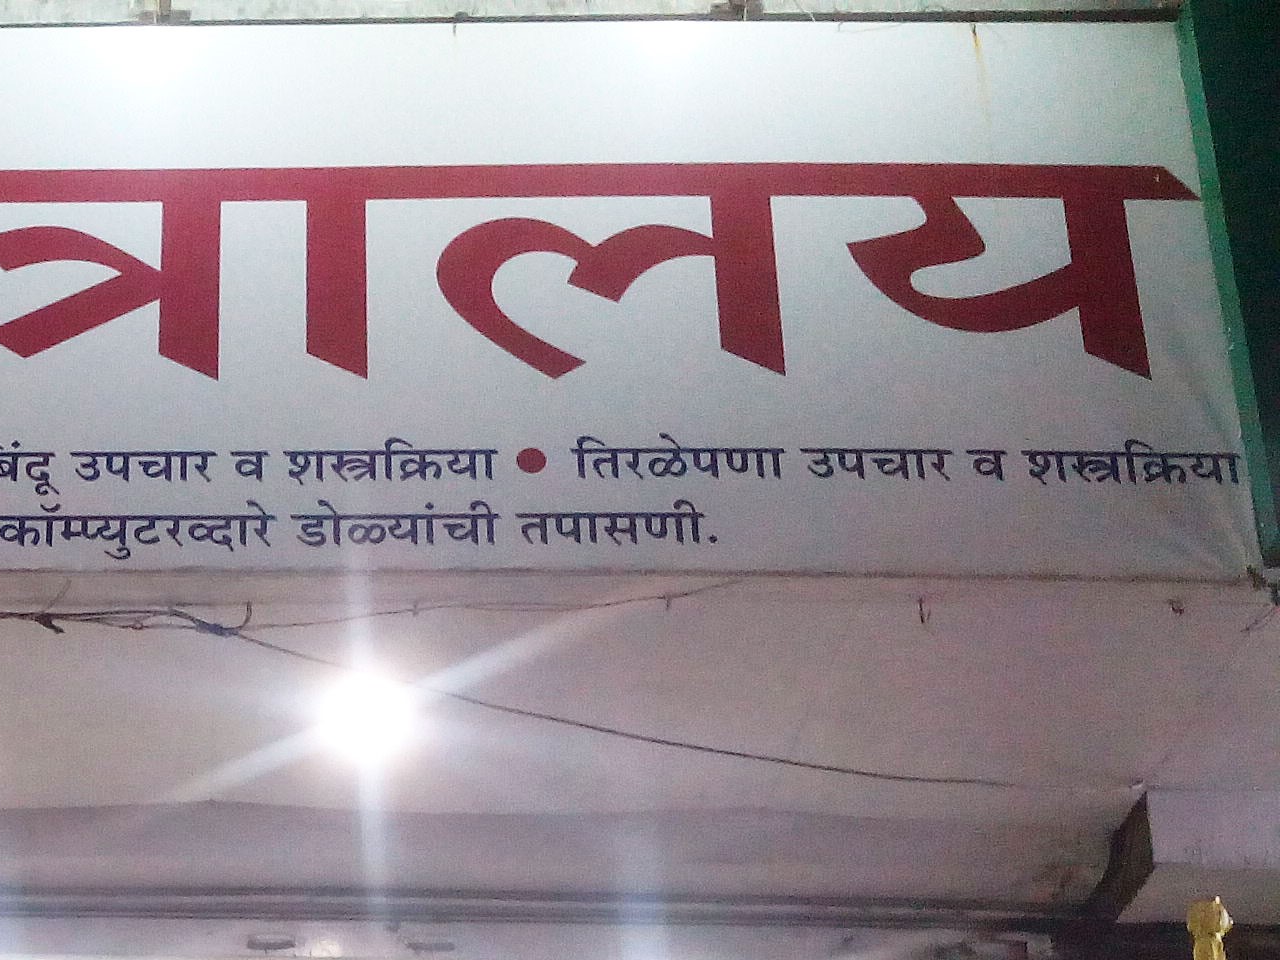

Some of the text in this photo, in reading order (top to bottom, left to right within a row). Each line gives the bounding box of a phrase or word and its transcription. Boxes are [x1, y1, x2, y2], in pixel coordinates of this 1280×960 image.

[70, 451, 217, 482] उपचार
[229, 450, 269, 482] व
[283, 438, 498, 485] शस्त्रक्रिया
[570, 434, 786, 480] तिरळेपणा
[799, 447, 954, 482] उपचार
[966, 448, 1008, 482] व
[1020, 440, 1243, 485] शस्त्रक्रिया
[291, 499, 500, 547] डोळ्यांची
